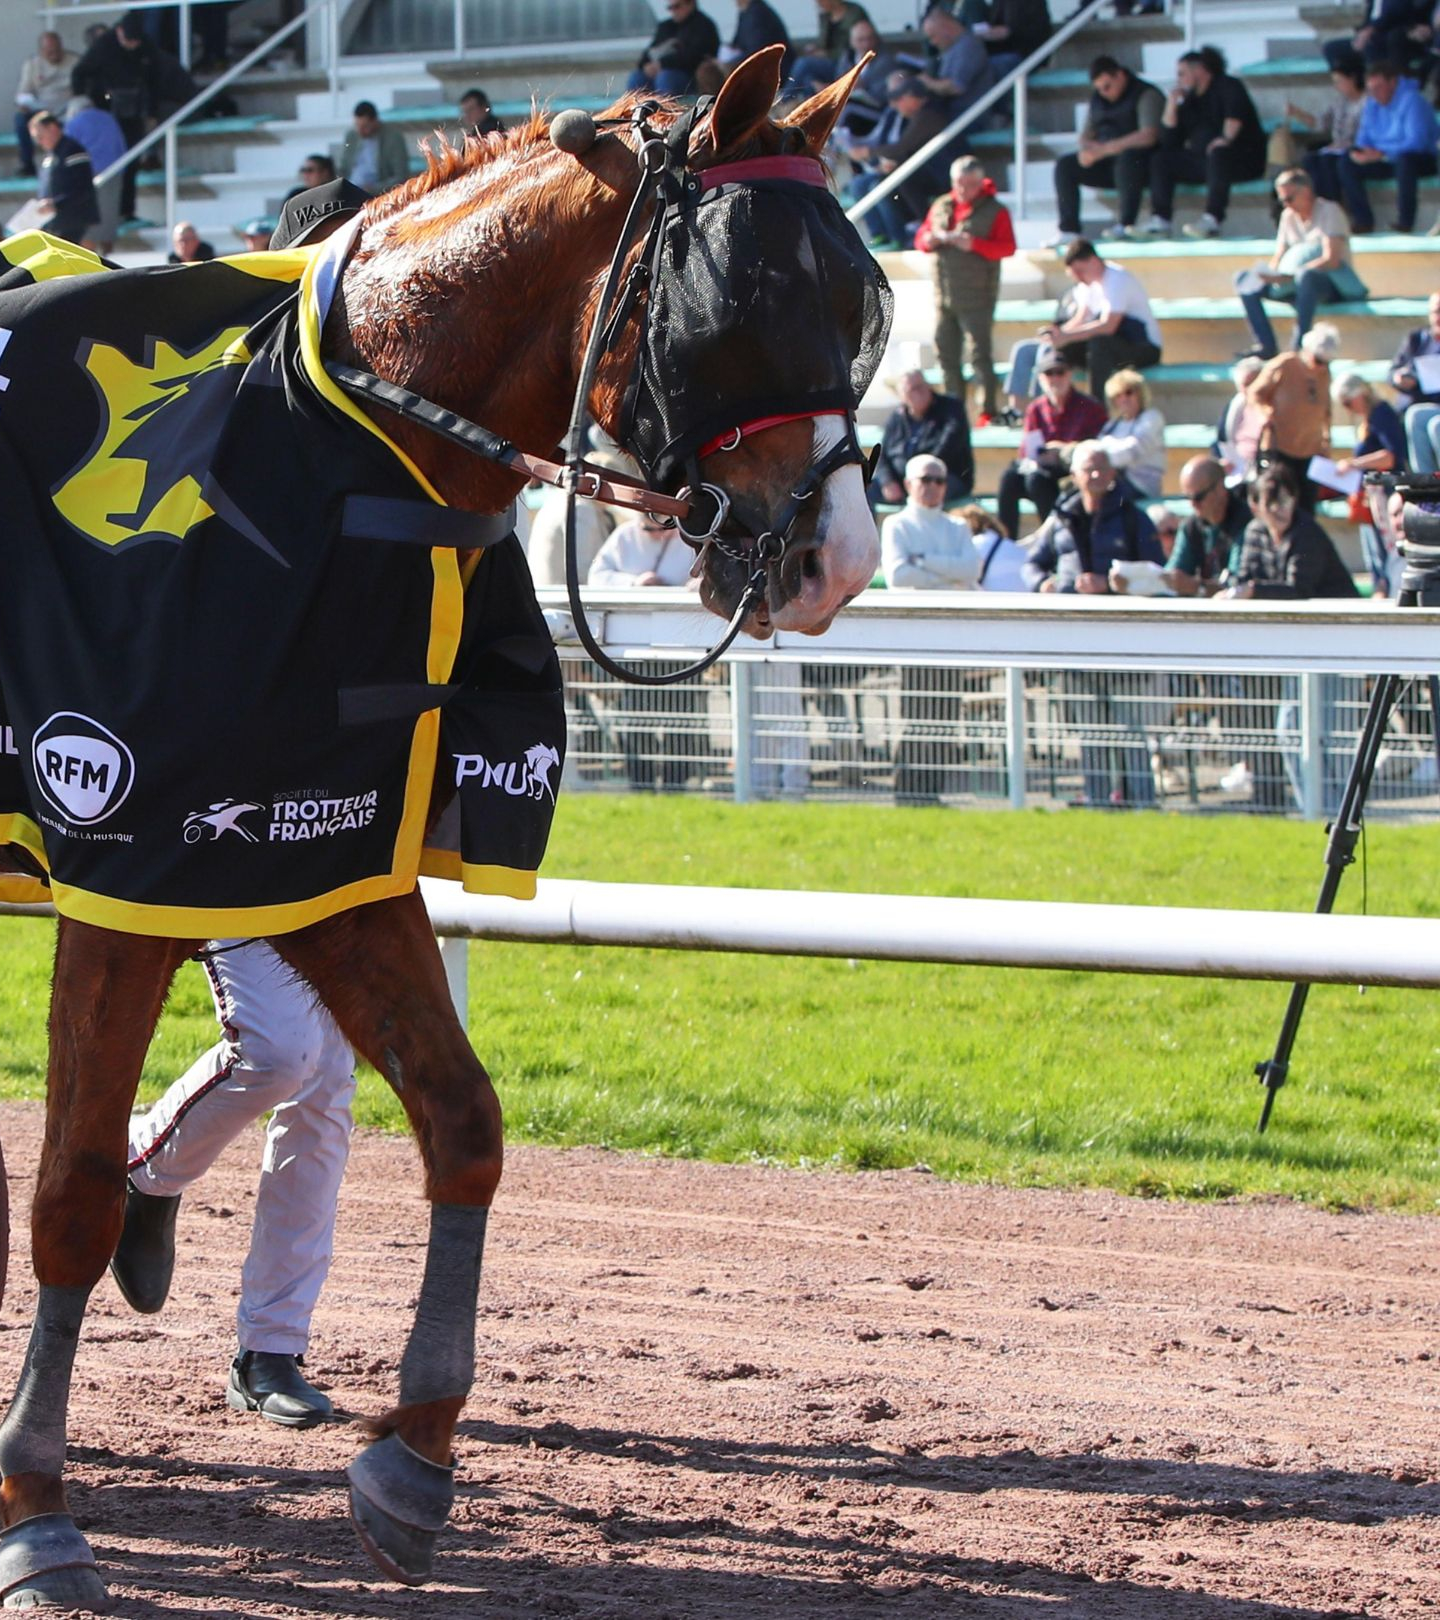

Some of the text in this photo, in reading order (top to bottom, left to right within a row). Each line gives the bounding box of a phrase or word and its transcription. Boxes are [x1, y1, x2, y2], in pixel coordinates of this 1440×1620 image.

[45, 749, 109, 793] RFM
[272, 790, 377, 820] TROTTEUR
[315, 789, 328, 798] DU
[68, 830, 79, 838] DE
[80, 832, 91, 840] LA
[93, 833, 135, 843] MUSIQUE
[268, 808, 376, 841] FRANÇAIS
